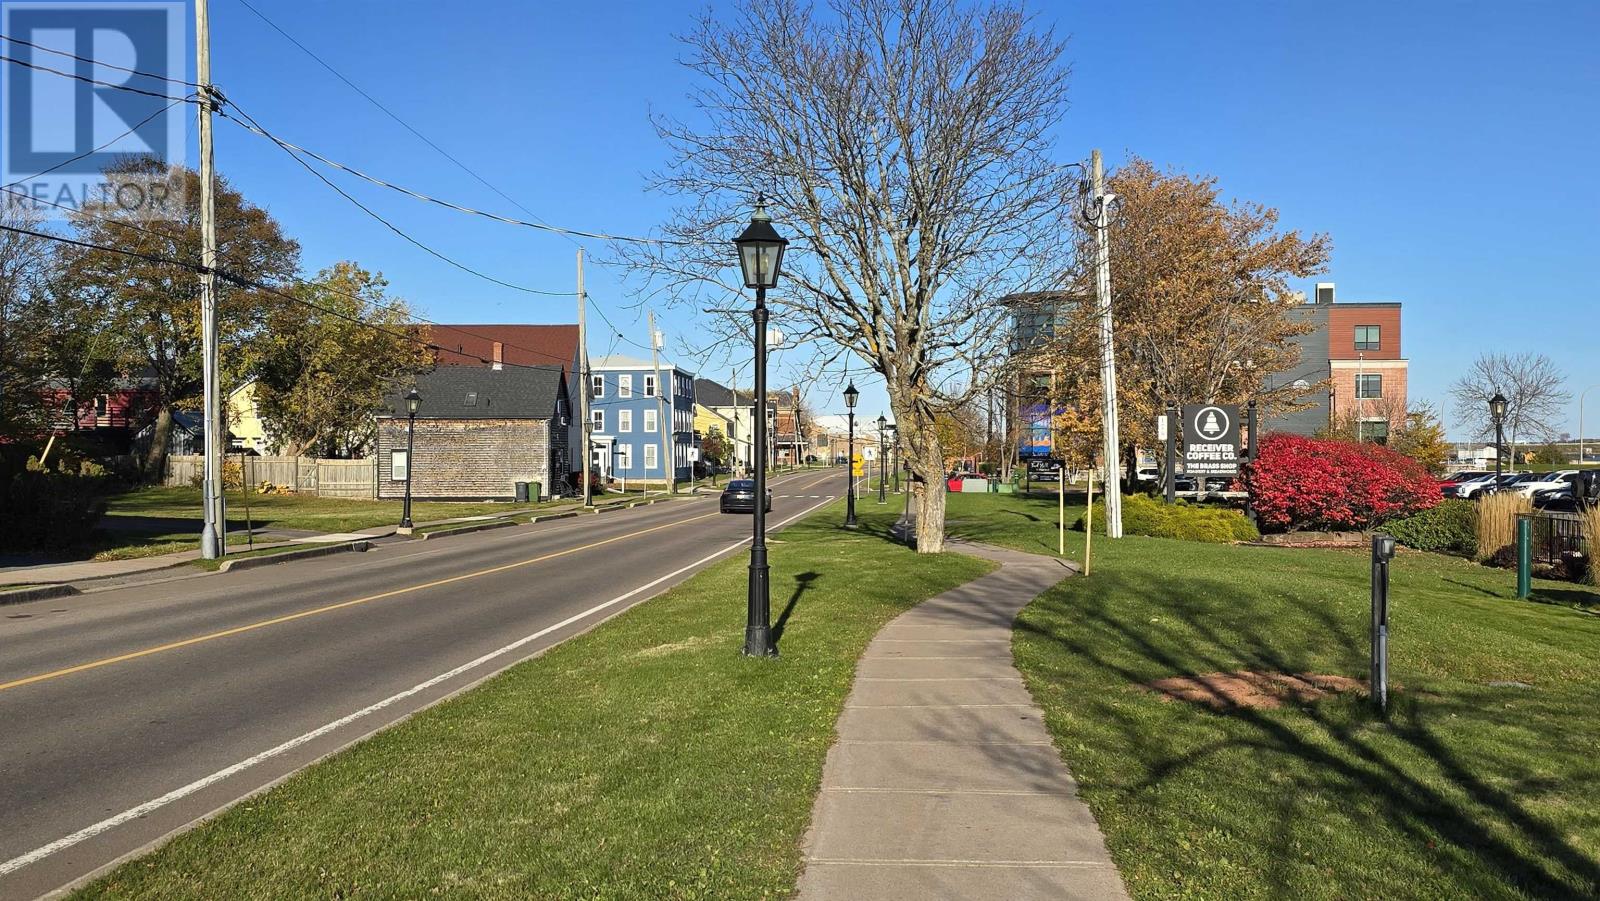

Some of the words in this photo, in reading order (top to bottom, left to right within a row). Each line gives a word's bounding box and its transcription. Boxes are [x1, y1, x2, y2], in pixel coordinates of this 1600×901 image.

[1189, 444, 1234, 452] RECEIVER
[1186, 452, 1221, 460] COFFEE
[1222, 452, 1237, 460] CO.
